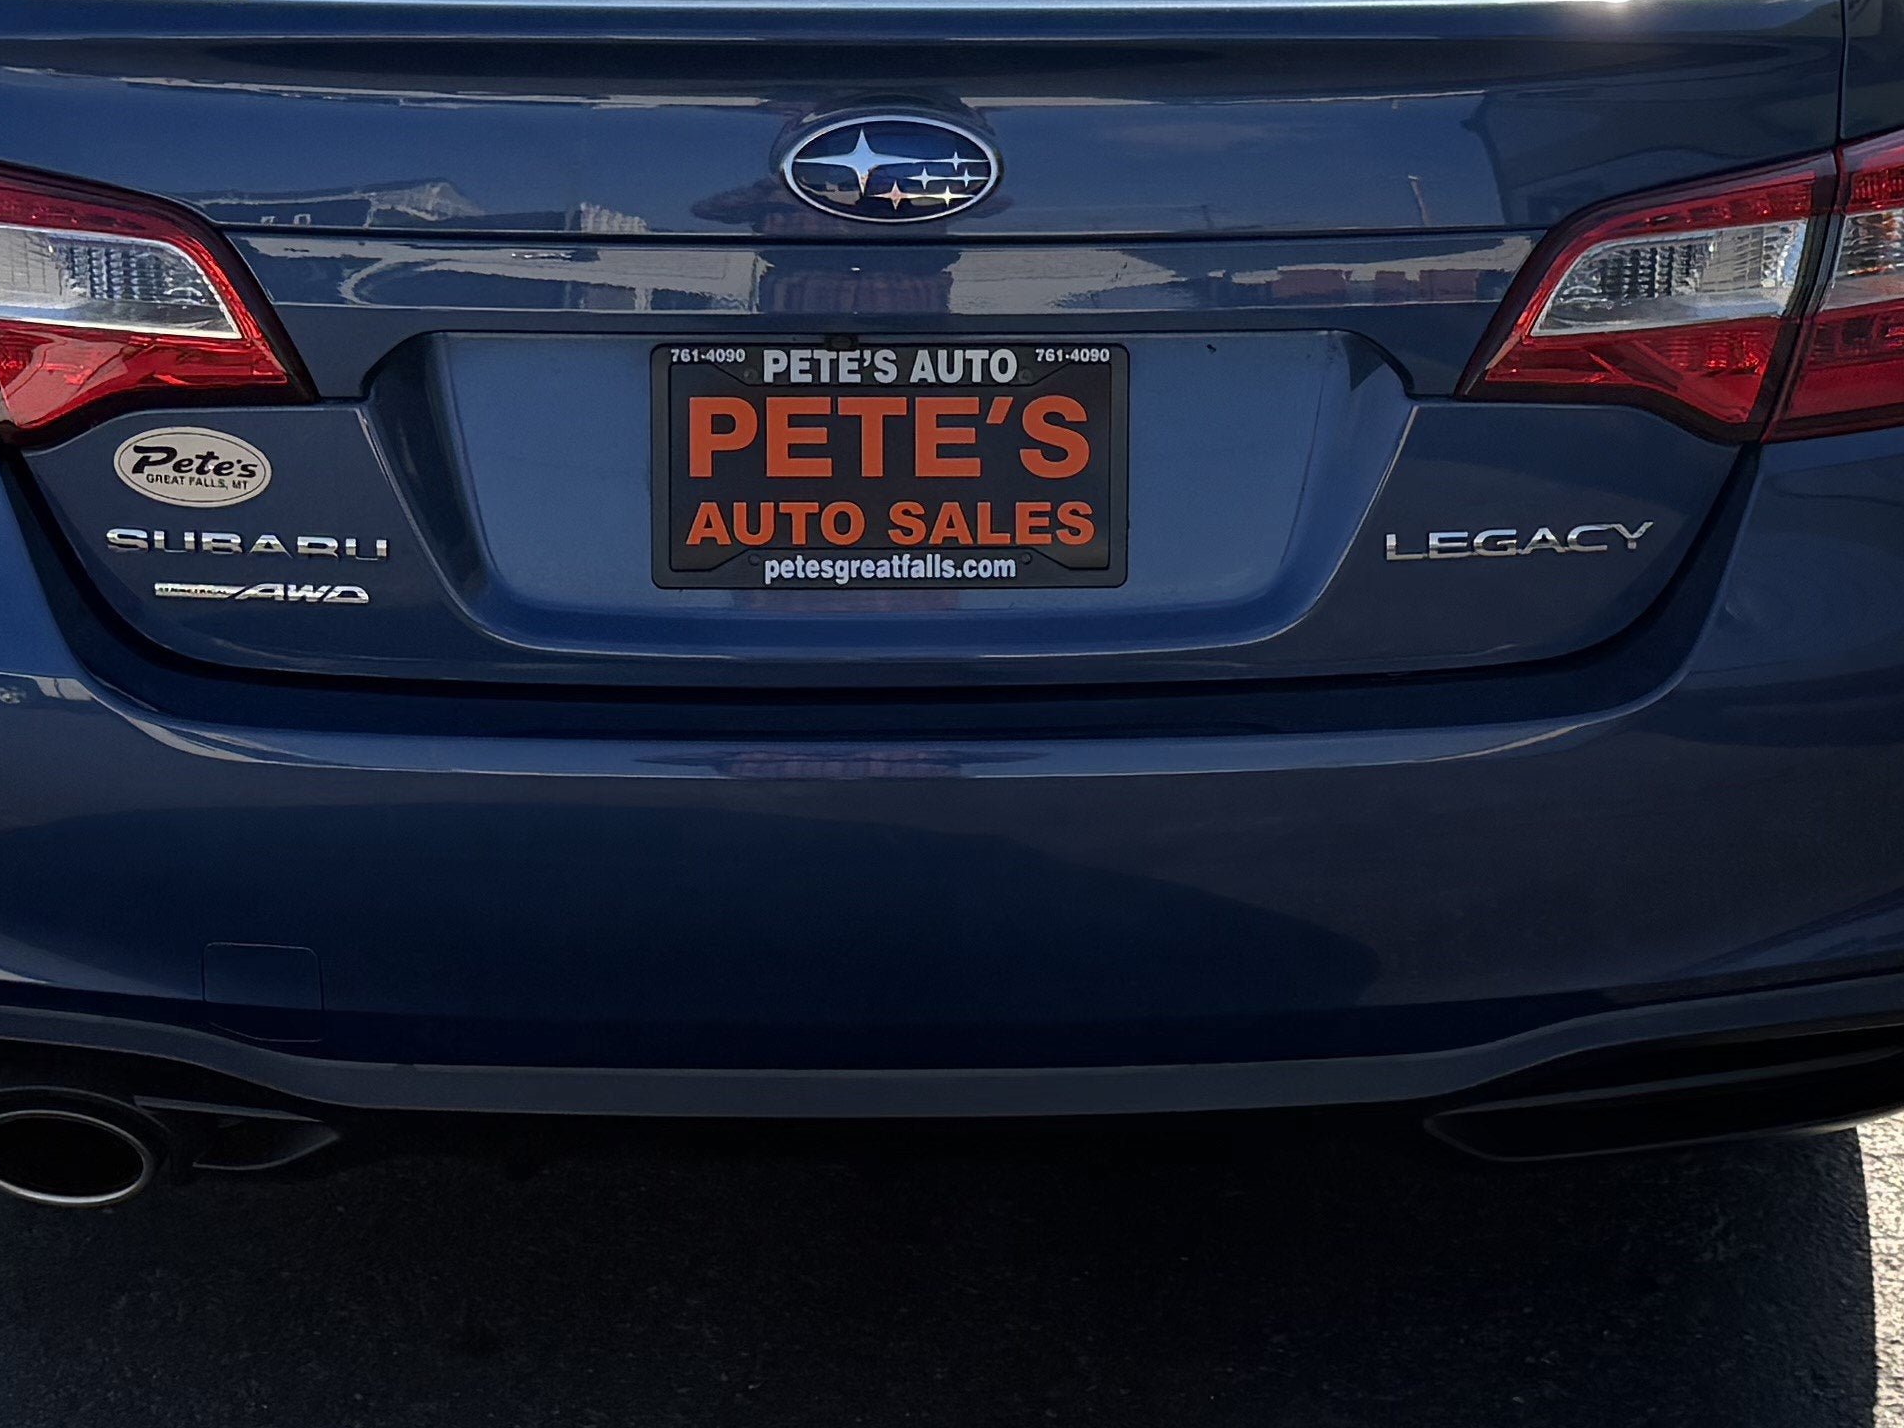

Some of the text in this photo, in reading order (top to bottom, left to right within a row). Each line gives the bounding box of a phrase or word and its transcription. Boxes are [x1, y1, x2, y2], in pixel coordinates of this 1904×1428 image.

[763, 348, 1018, 384] PETE'S AUTO
[688, 395, 1090, 478] PETE'S
[131, 444, 258, 478] Pete's
[146, 473, 184, 486] GREAT
[685, 501, 1096, 546] AUTO SALES
[106, 528, 388, 561] SUBARU
[1386, 522, 1654, 561] LEGACY
[763, 554, 1016, 585] petesgreatfalls.com
[234, 582, 369, 604] AWD
